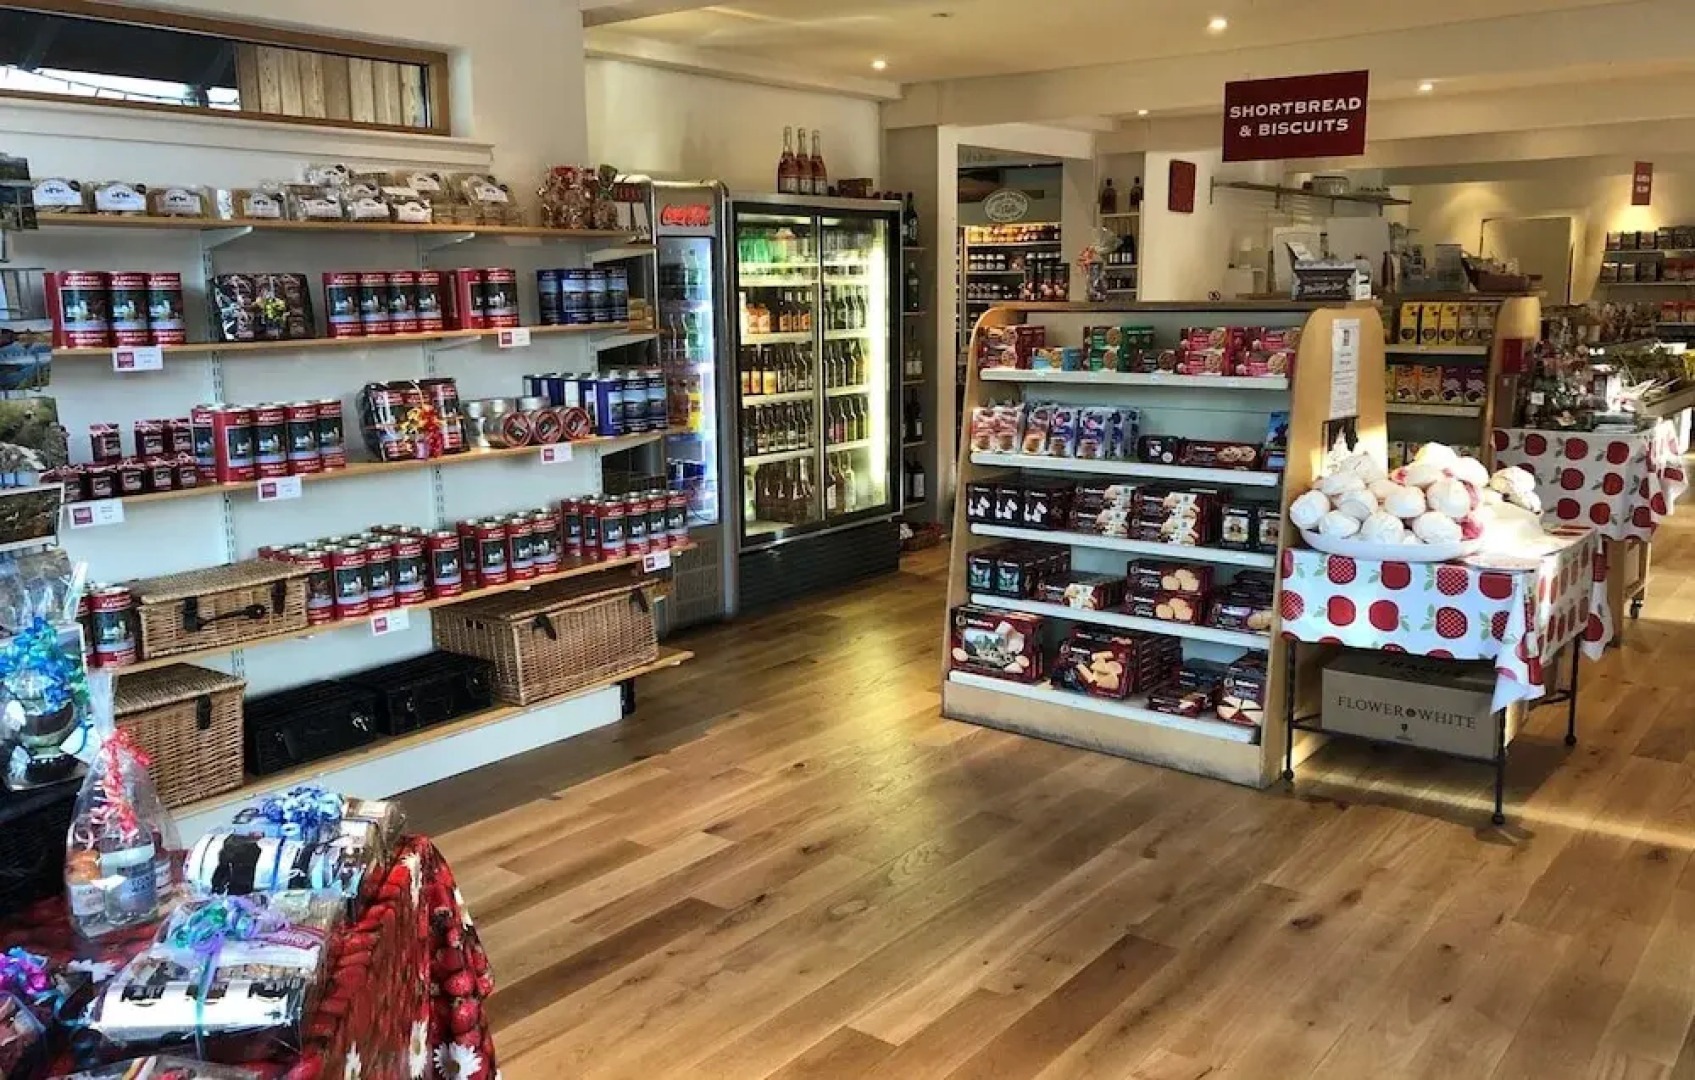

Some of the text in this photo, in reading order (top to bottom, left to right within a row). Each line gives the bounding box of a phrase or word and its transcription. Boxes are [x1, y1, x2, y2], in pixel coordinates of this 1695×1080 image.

[1229, 97, 1362, 118] SHORTBREAD
[1239, 118, 1350, 137] & BISCUITS
[1338, 695, 1477, 730] FLOWER WHITE
